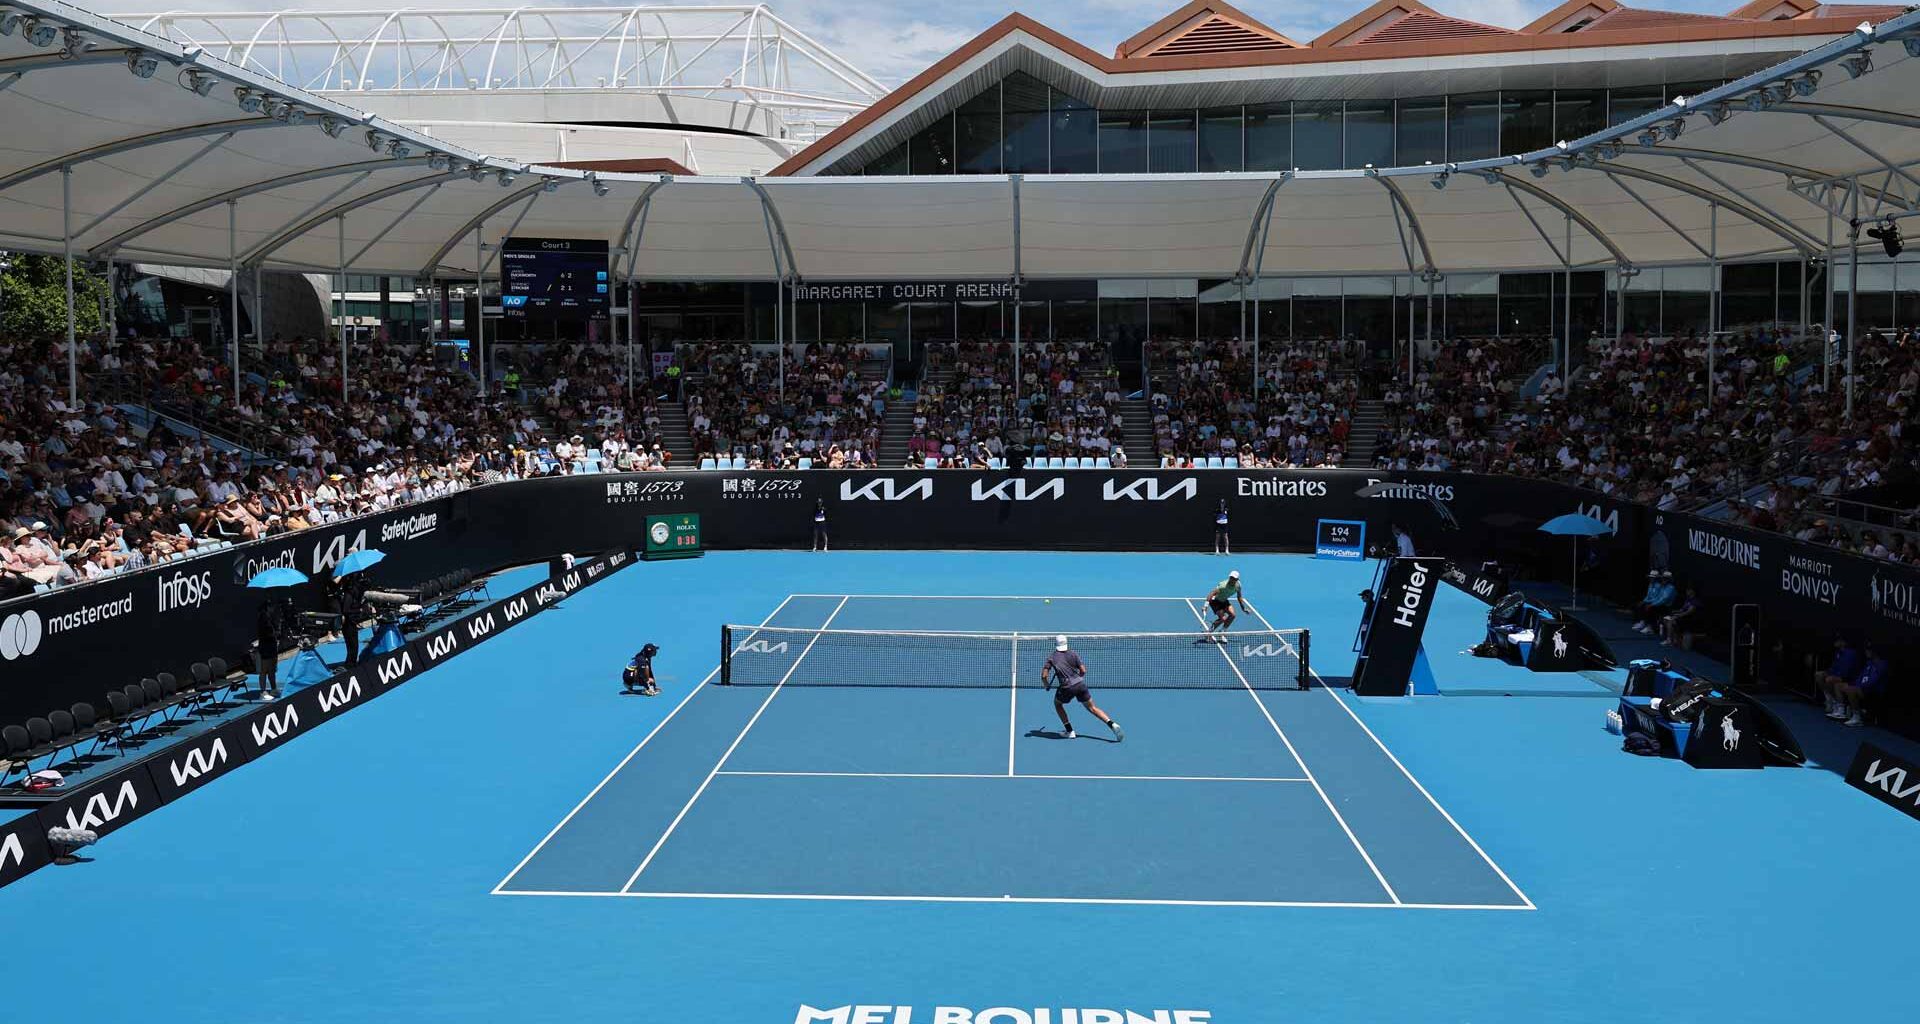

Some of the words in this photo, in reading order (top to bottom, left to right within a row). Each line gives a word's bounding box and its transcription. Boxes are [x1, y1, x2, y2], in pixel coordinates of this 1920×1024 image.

[796, 285, 884, 300] MARGARET
[892, 284, 947, 299] COURT
[955, 283, 1013, 298] ARENA
[607, 496, 652, 504] GUOJIAO
[839, 477, 934, 501] KIA
[970, 477, 1066, 501] KIA
[1102, 477, 1198, 501] KIA
[1237, 477, 1327, 498] Emirates
[381, 512, 438, 543] SafetyCulture
[1330, 526, 1350, 537] 194
[1332, 536, 1347, 544] km/h
[1317, 547, 1361, 558] SafetyCulture
[1687, 527, 1761, 571] MELBOURNE
[1789, 555, 1833, 577] MARRIOTT
[158, 570, 212, 613] Infosys
[562, 570, 582, 593] KIA
[1782, 568, 1840, 605] BONVOY
[1393, 562, 1429, 628] Haier
[48, 591, 133, 635] mastercard
[503, 596, 530, 622] KIA
[467, 611, 496, 640] KIA
[426, 630, 457, 661] KIA
[739, 639, 788, 654] KIA
[1243, 643, 1293, 657] KIA
[376, 651, 414, 685] KIA
[317, 675, 362, 713] KIA
[251, 703, 299, 747] KIA
[170, 736, 228, 788] KIA
[65, 779, 138, 831] KIA
